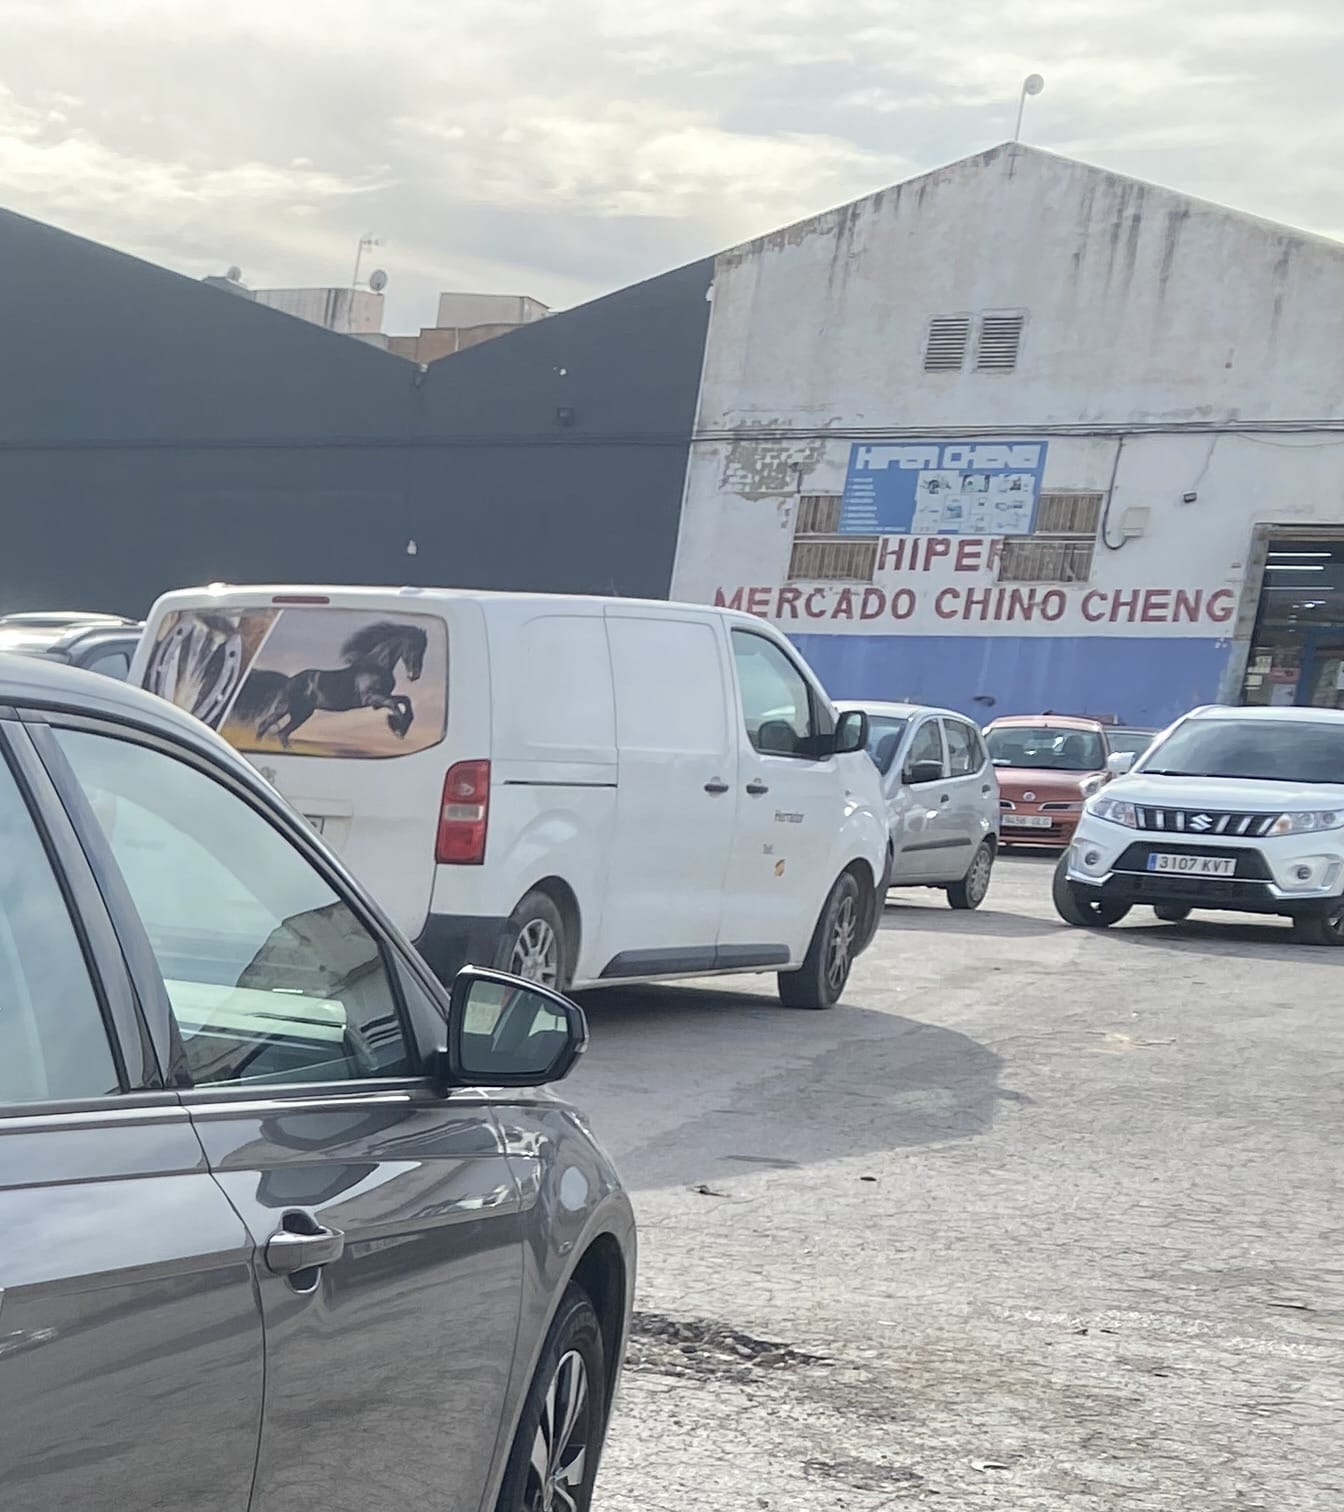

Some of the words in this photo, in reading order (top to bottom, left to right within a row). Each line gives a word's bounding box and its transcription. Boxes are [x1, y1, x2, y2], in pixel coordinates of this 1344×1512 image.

[714, 586, 916, 619] MERCADO
[934, 587, 1067, 621] CHINO
[1080, 588, 1235, 623] CHENG
[1159, 856, 1198, 870] 3107
[1202, 859, 1233, 873] KVT
